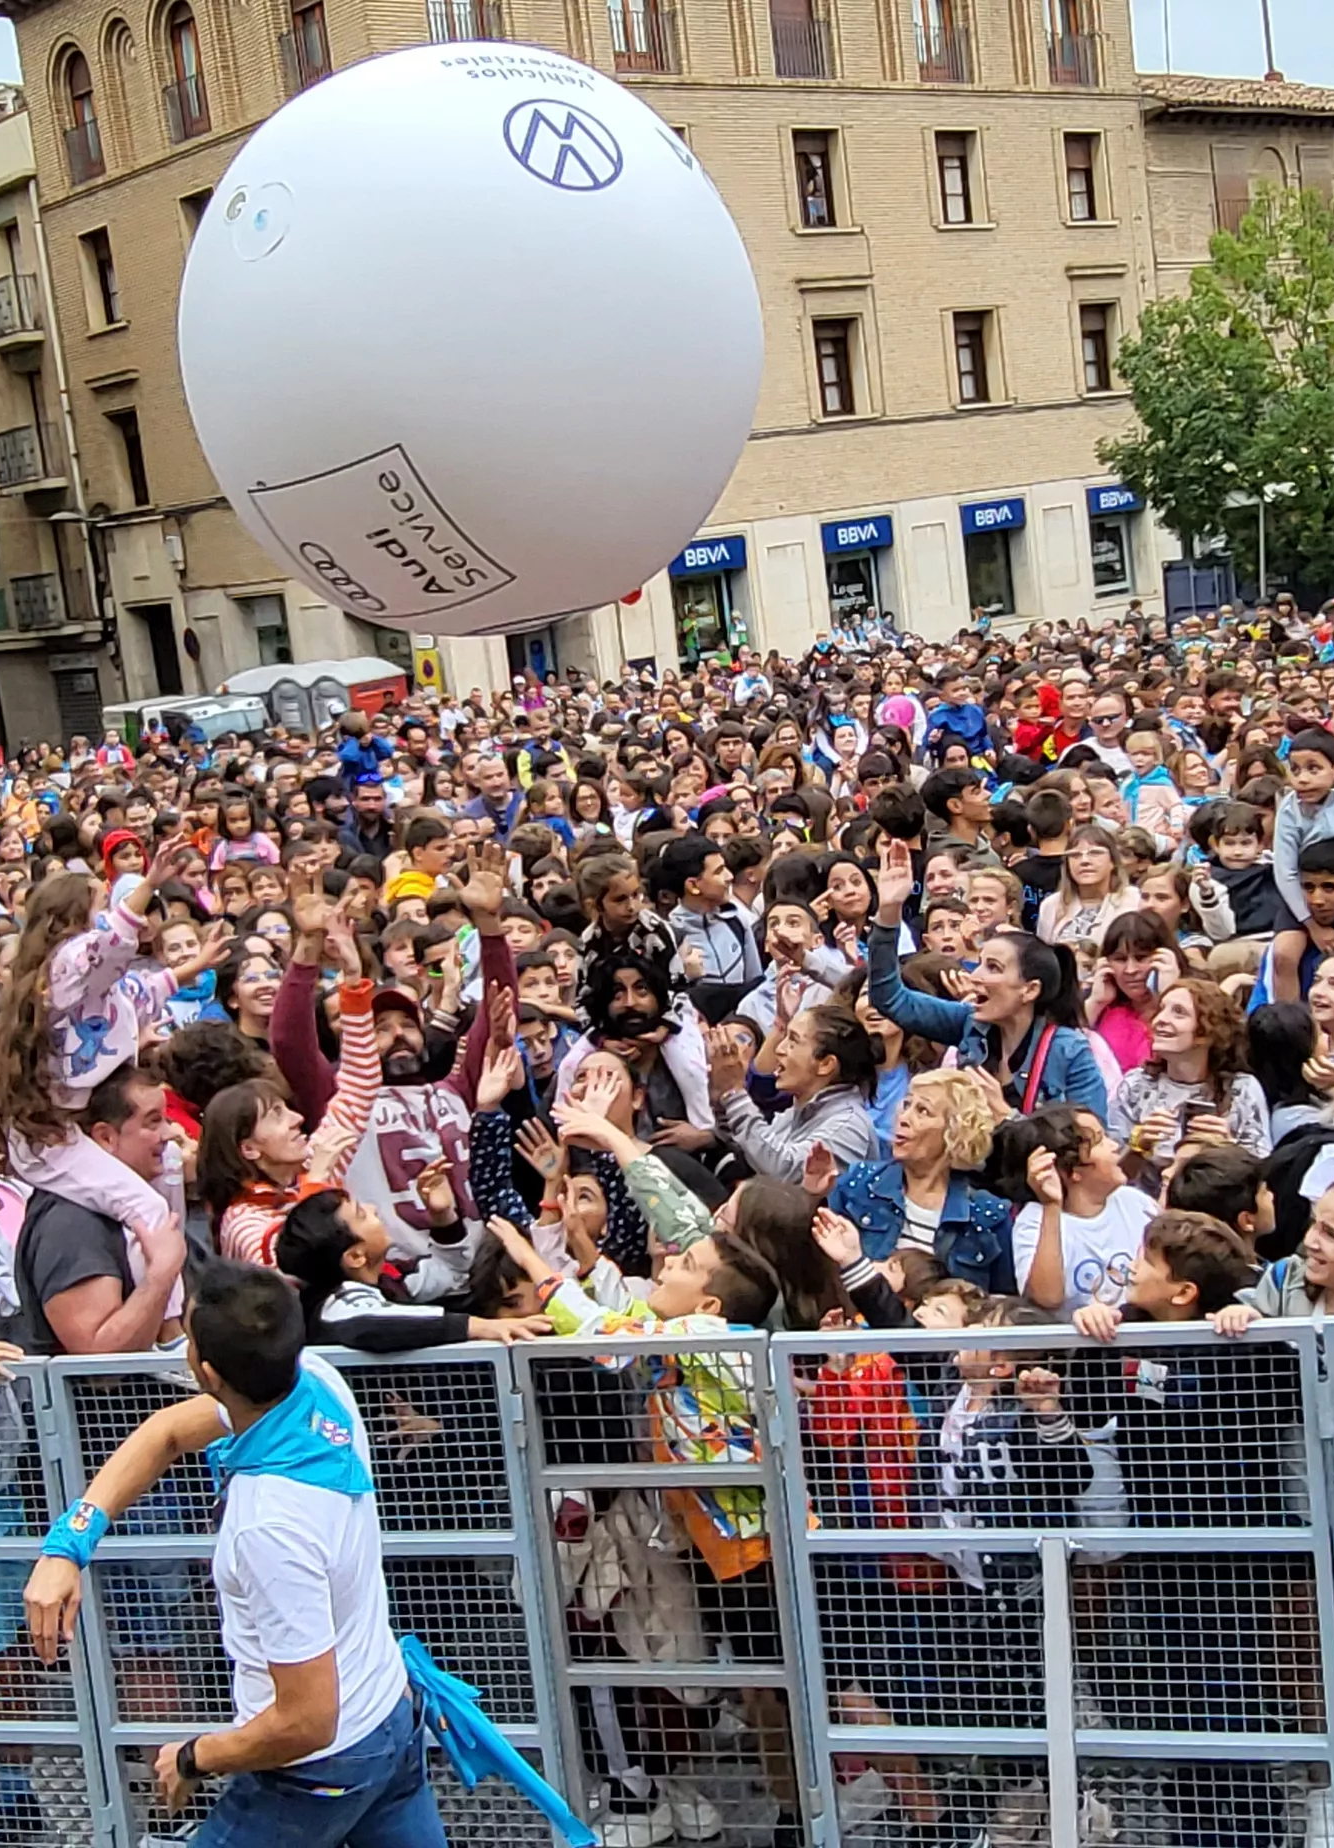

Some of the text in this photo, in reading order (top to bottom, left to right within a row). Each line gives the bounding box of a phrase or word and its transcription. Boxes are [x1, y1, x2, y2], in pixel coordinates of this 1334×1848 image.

[1099, 491, 1134, 509] BBVA
[975, 505, 1013, 527] BBVA
[378, 470, 488, 587] Service
[837, 523, 878, 545] BBVA
[366, 528, 455, 594] Audi
[685, 544, 730, 567] BBVA
